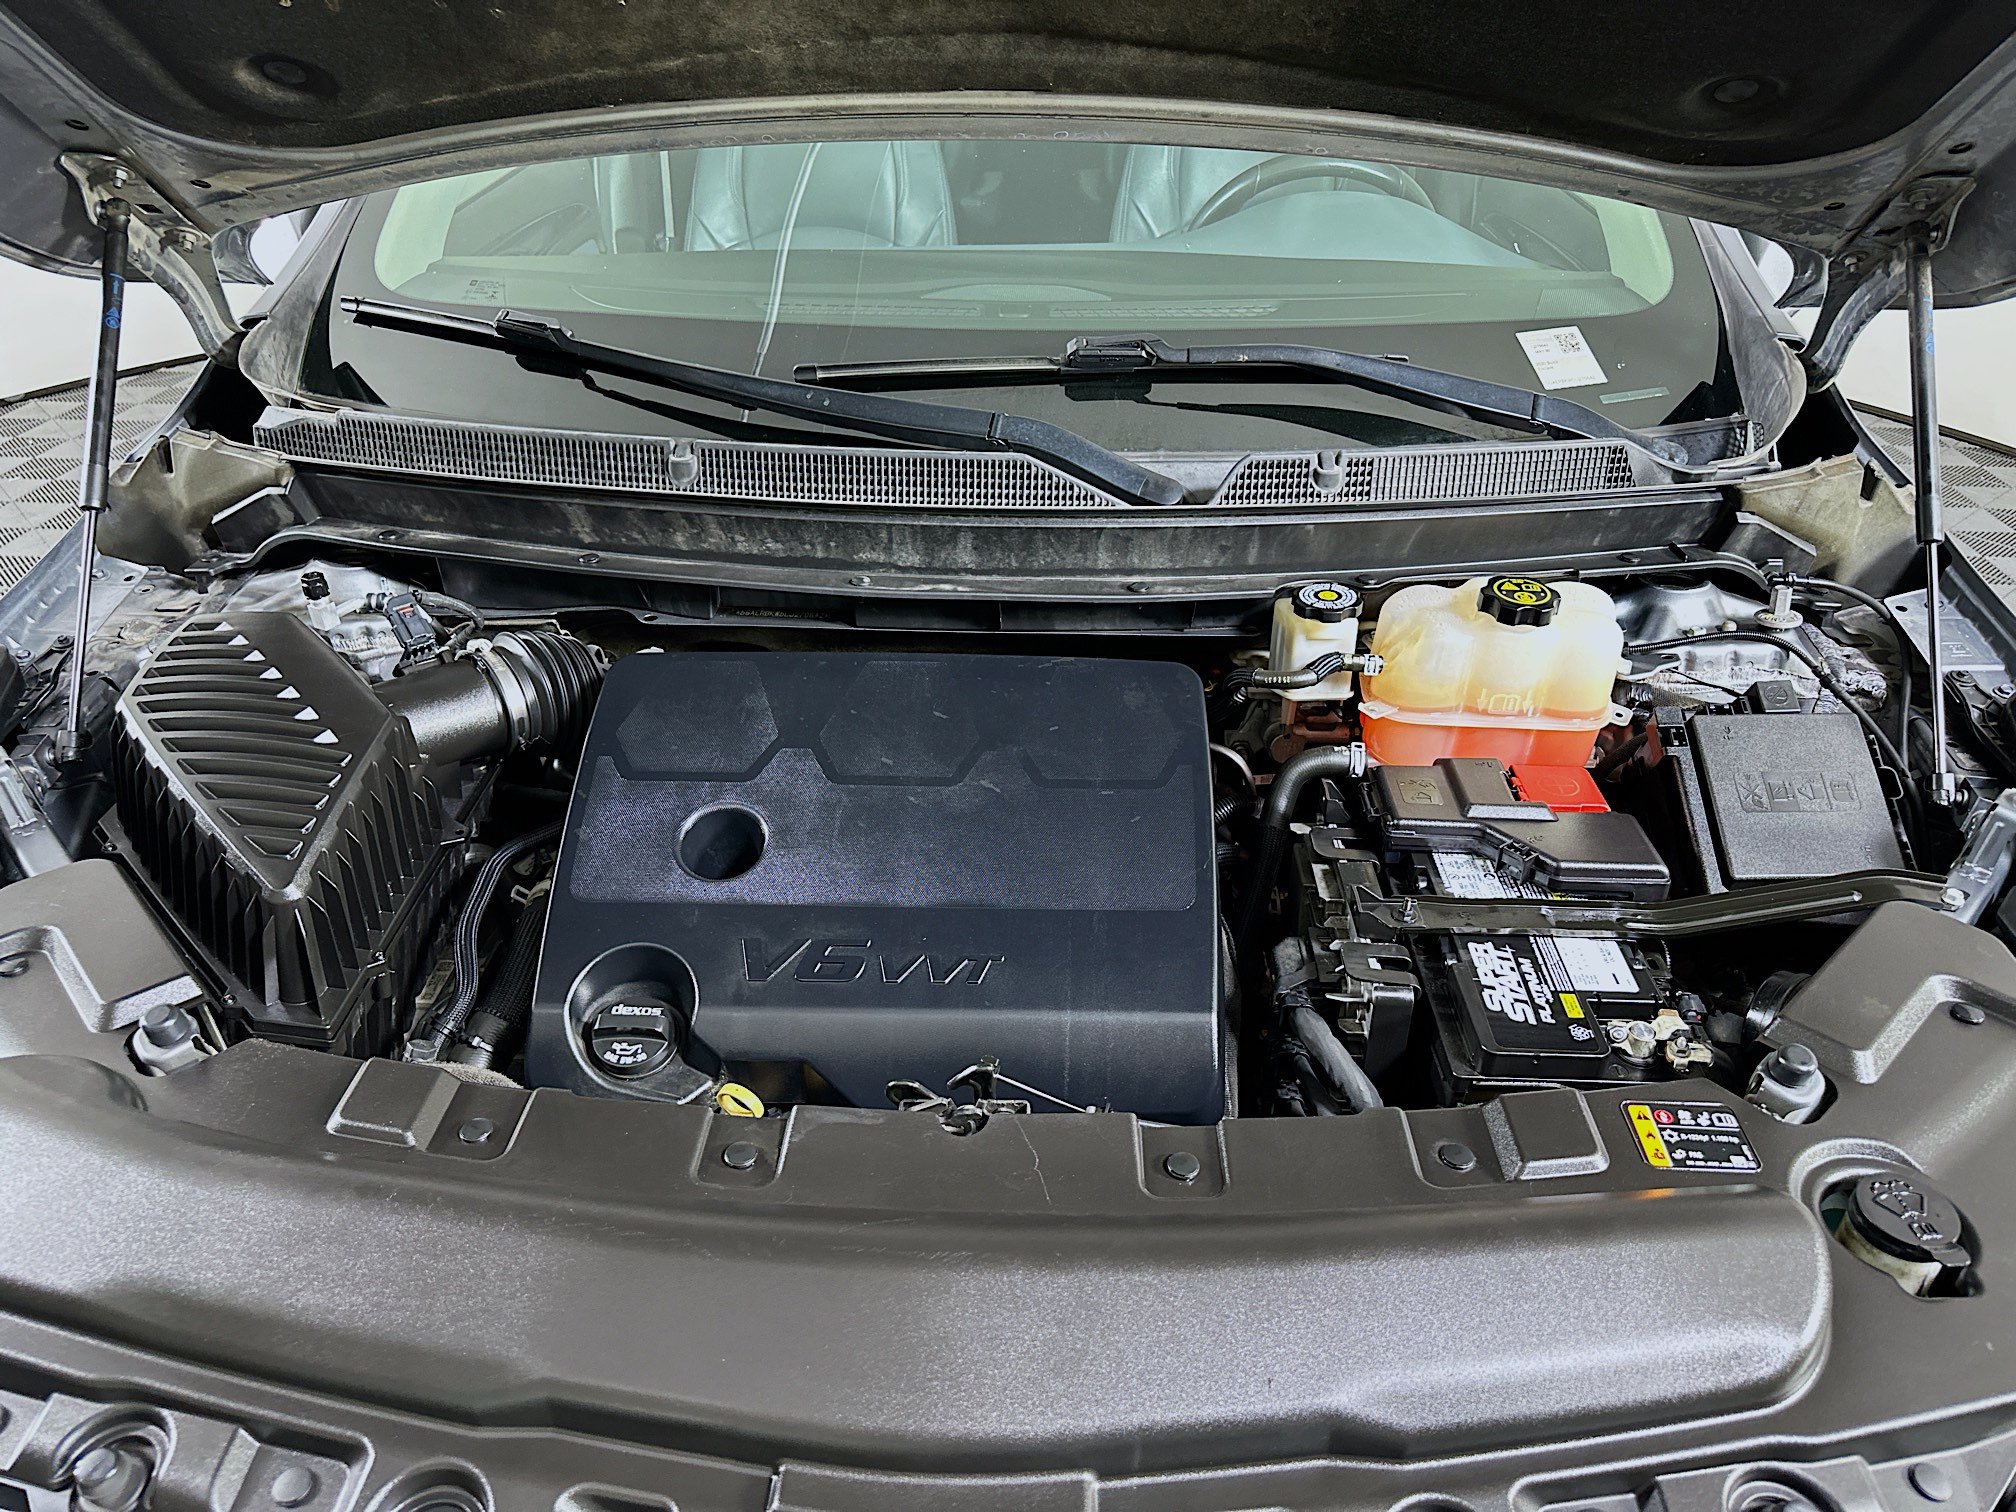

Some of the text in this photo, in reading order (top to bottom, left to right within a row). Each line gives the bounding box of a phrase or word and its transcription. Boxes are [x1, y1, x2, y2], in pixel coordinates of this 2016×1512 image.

[741, 938, 1005, 984] V6 VVT
[1467, 941, 1502, 1012] SUPER
[1486, 941, 1537, 1025] START
[1518, 957, 1556, 1024] PLATINUM
[611, 1003, 664, 1016] dexos
